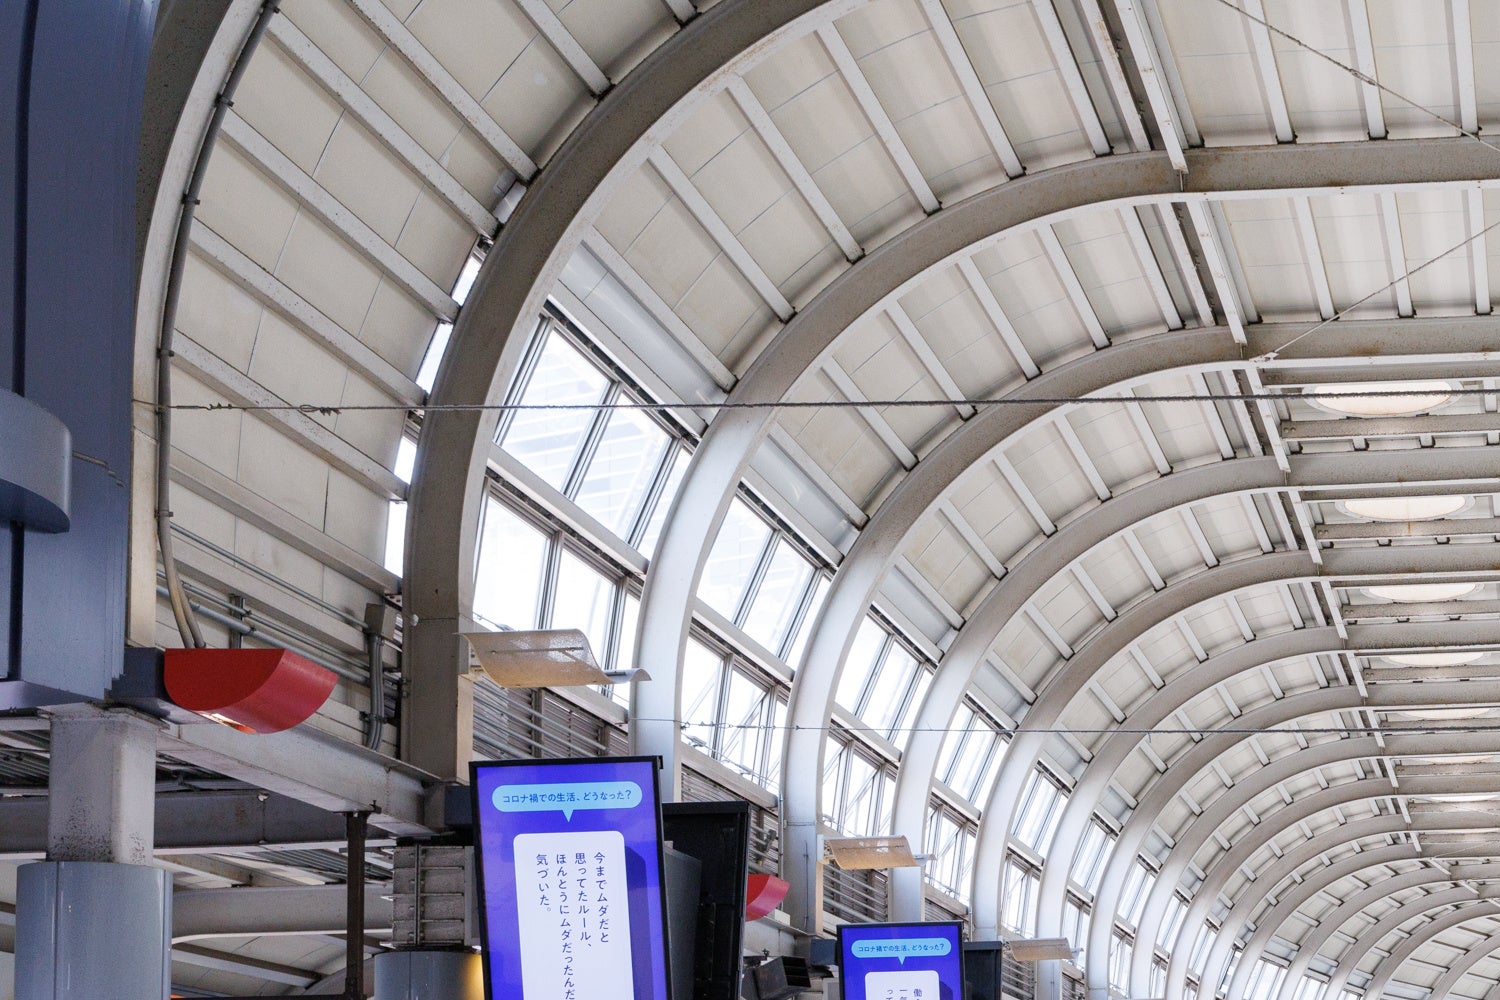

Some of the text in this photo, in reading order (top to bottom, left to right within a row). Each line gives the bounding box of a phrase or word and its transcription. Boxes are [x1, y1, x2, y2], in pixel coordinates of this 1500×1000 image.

[502, 789, 632, 804] コロナ禍での生活、どうなった？
[536, 853, 552, 912] 気づいた。
[574, 852, 592, 949] 思ってたルール、
[593, 852, 609, 943] 今までムダだと
